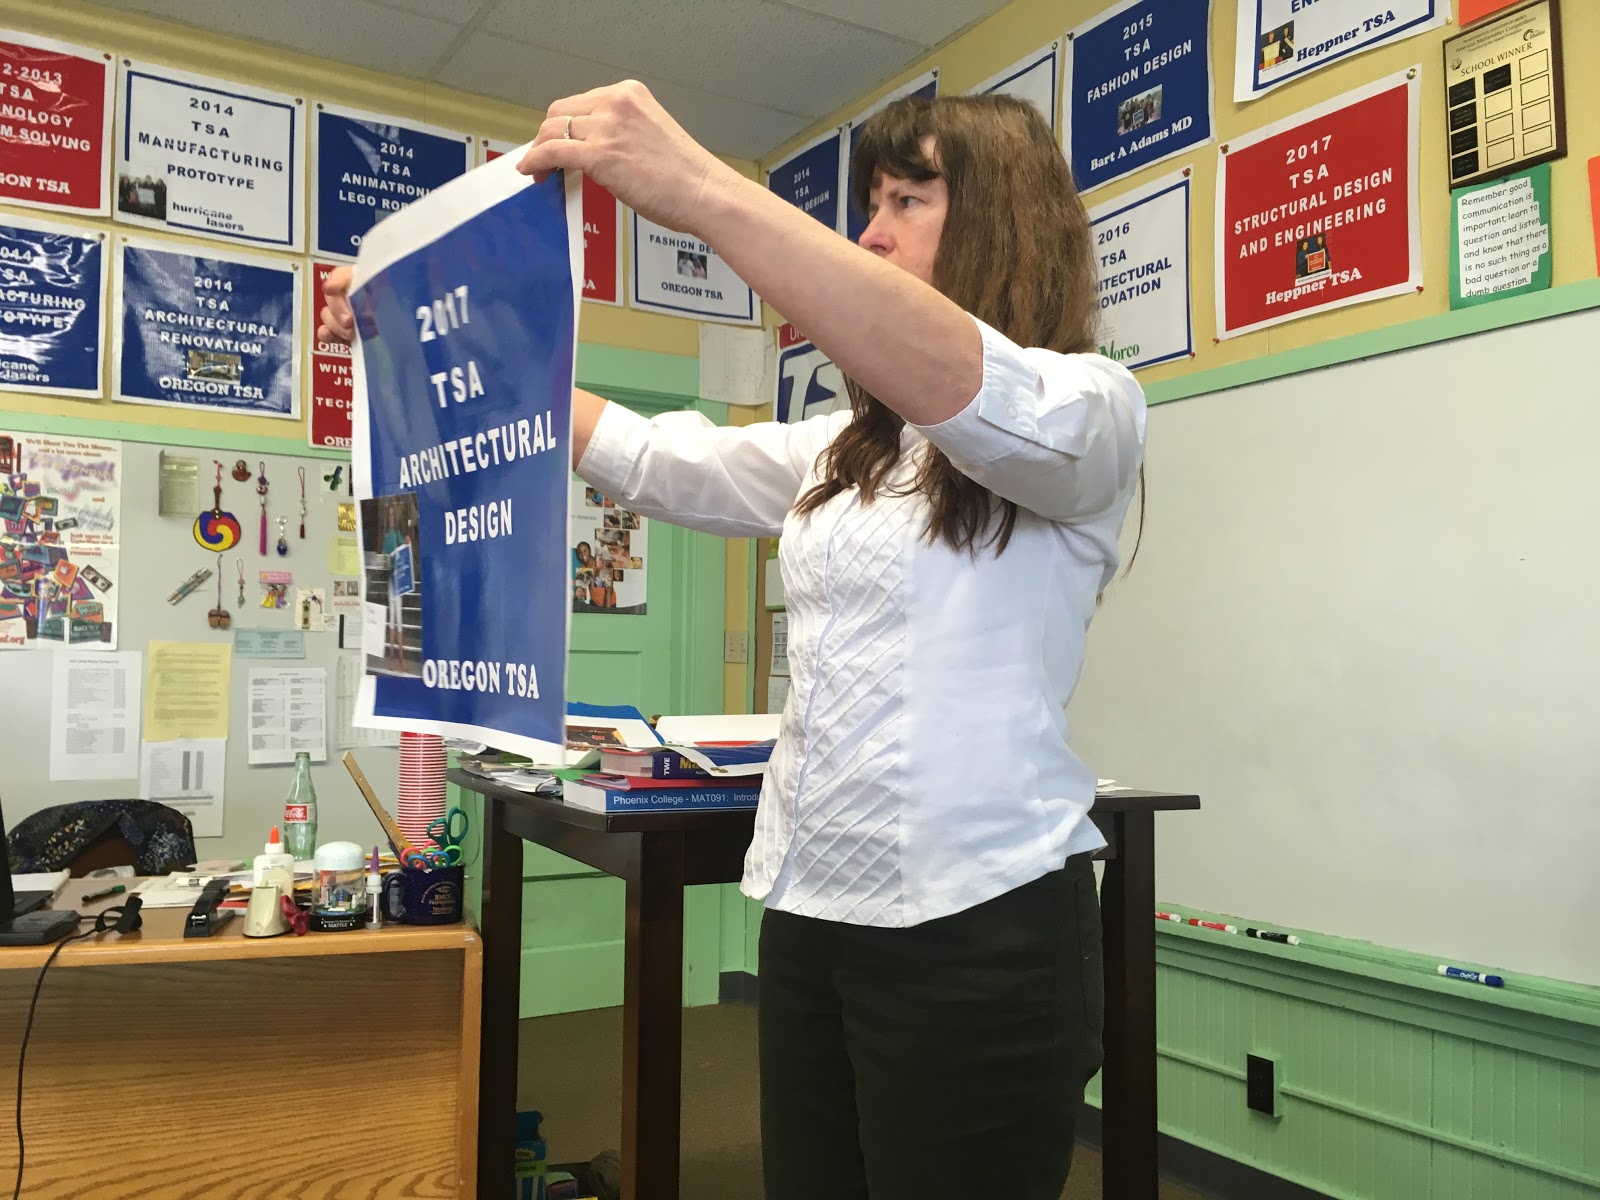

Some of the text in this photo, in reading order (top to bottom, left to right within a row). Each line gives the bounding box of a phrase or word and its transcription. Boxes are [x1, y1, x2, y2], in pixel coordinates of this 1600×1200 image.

[1291, 0, 1320, 14] EN
[1122, 13, 1153, 41] 2015
[1296, 10, 1396, 62] Heppner TSA
[1124, 38, 1151, 61] TSA
[1460, 42, 1533, 77] SCHOOL WINNER
[1087, 39, 1192, 104] FASHION DESIGN
[0, 82, 34, 101] TSA
[189, 97, 234, 117] 2014
[20, 128, 91, 151] SOLVING
[191, 120, 230, 138] TSA
[138, 131, 283, 172] MANUFACTURING
[379, 142, 414, 160] 2014
[1090, 115, 1193, 171] Bart A Adams MD
[1286, 135, 1332, 165] 2017
[167, 163, 255, 190] PROTOTYPE
[382, 160, 411, 178] TSA
[793, 166, 810, 184] 2014
[1289, 163, 1329, 189] TSA
[36, 178, 71, 195] TSA
[339, 189, 376, 207] LEGO
[795, 184, 809, 200] TSA
[1461, 179, 1528, 206] Remember good
[172, 201, 233, 221] hurricane
[805, 190, 830, 211] DESIGN
[1234, 167, 1393, 235] STRUCTURAL DESIGN
[1462, 192, 1532, 219] communication is
[1508, 209, 1528, 220] learn
[1530, 204, 1538, 213] to
[206, 217, 244, 232] lasers
[1098, 222, 1130, 246] 2016
[1239, 198, 1387, 259] AND ENGINEERING
[1463, 231, 1500, 247] question
[1502, 224, 1517, 236] and
[650, 234, 716, 255] FASHION DE
[1463, 227, 1547, 259] and know that there
[1101, 249, 1126, 268] TSA
[1464, 263, 1472, 271] is
[1475, 261, 1485, 270] no
[1488, 255, 1507, 267] such
[1509, 248, 1530, 261] thing
[194, 276, 233, 292] 2014
[1465, 273, 1482, 285] bad
[1484, 265, 1520, 281] question
[1521, 262, 1531, 270] or
[661, 281, 723, 300] OREGON TSA
[1265, 279, 1327, 305] Heppner
[1329, 267, 1362, 287] TSA
[1466, 275, 1529, 297] dumb question.
[196, 296, 230, 312] TSA
[416, 285, 470, 342] 2017
[0, 311, 64, 330] OTYPE
[145, 308, 278, 337] ARCHITECTURAL
[160, 331, 262, 355] RENOVATION
[318, 342, 352, 353] ORE
[1099, 340, 1140, 361] Norco
[159, 376, 264, 399] OREGON TSA
[430, 361, 485, 408] TSA
[400, 410, 556, 489] ARCHITECTURAL
[444, 499, 513, 545] DESIGN
[423, 659, 539, 699] OREGON TSA
[613, 794, 649, 805] Phoenix
[651, 793, 683, 805] College
[691, 793, 729, 803] MAT091:
